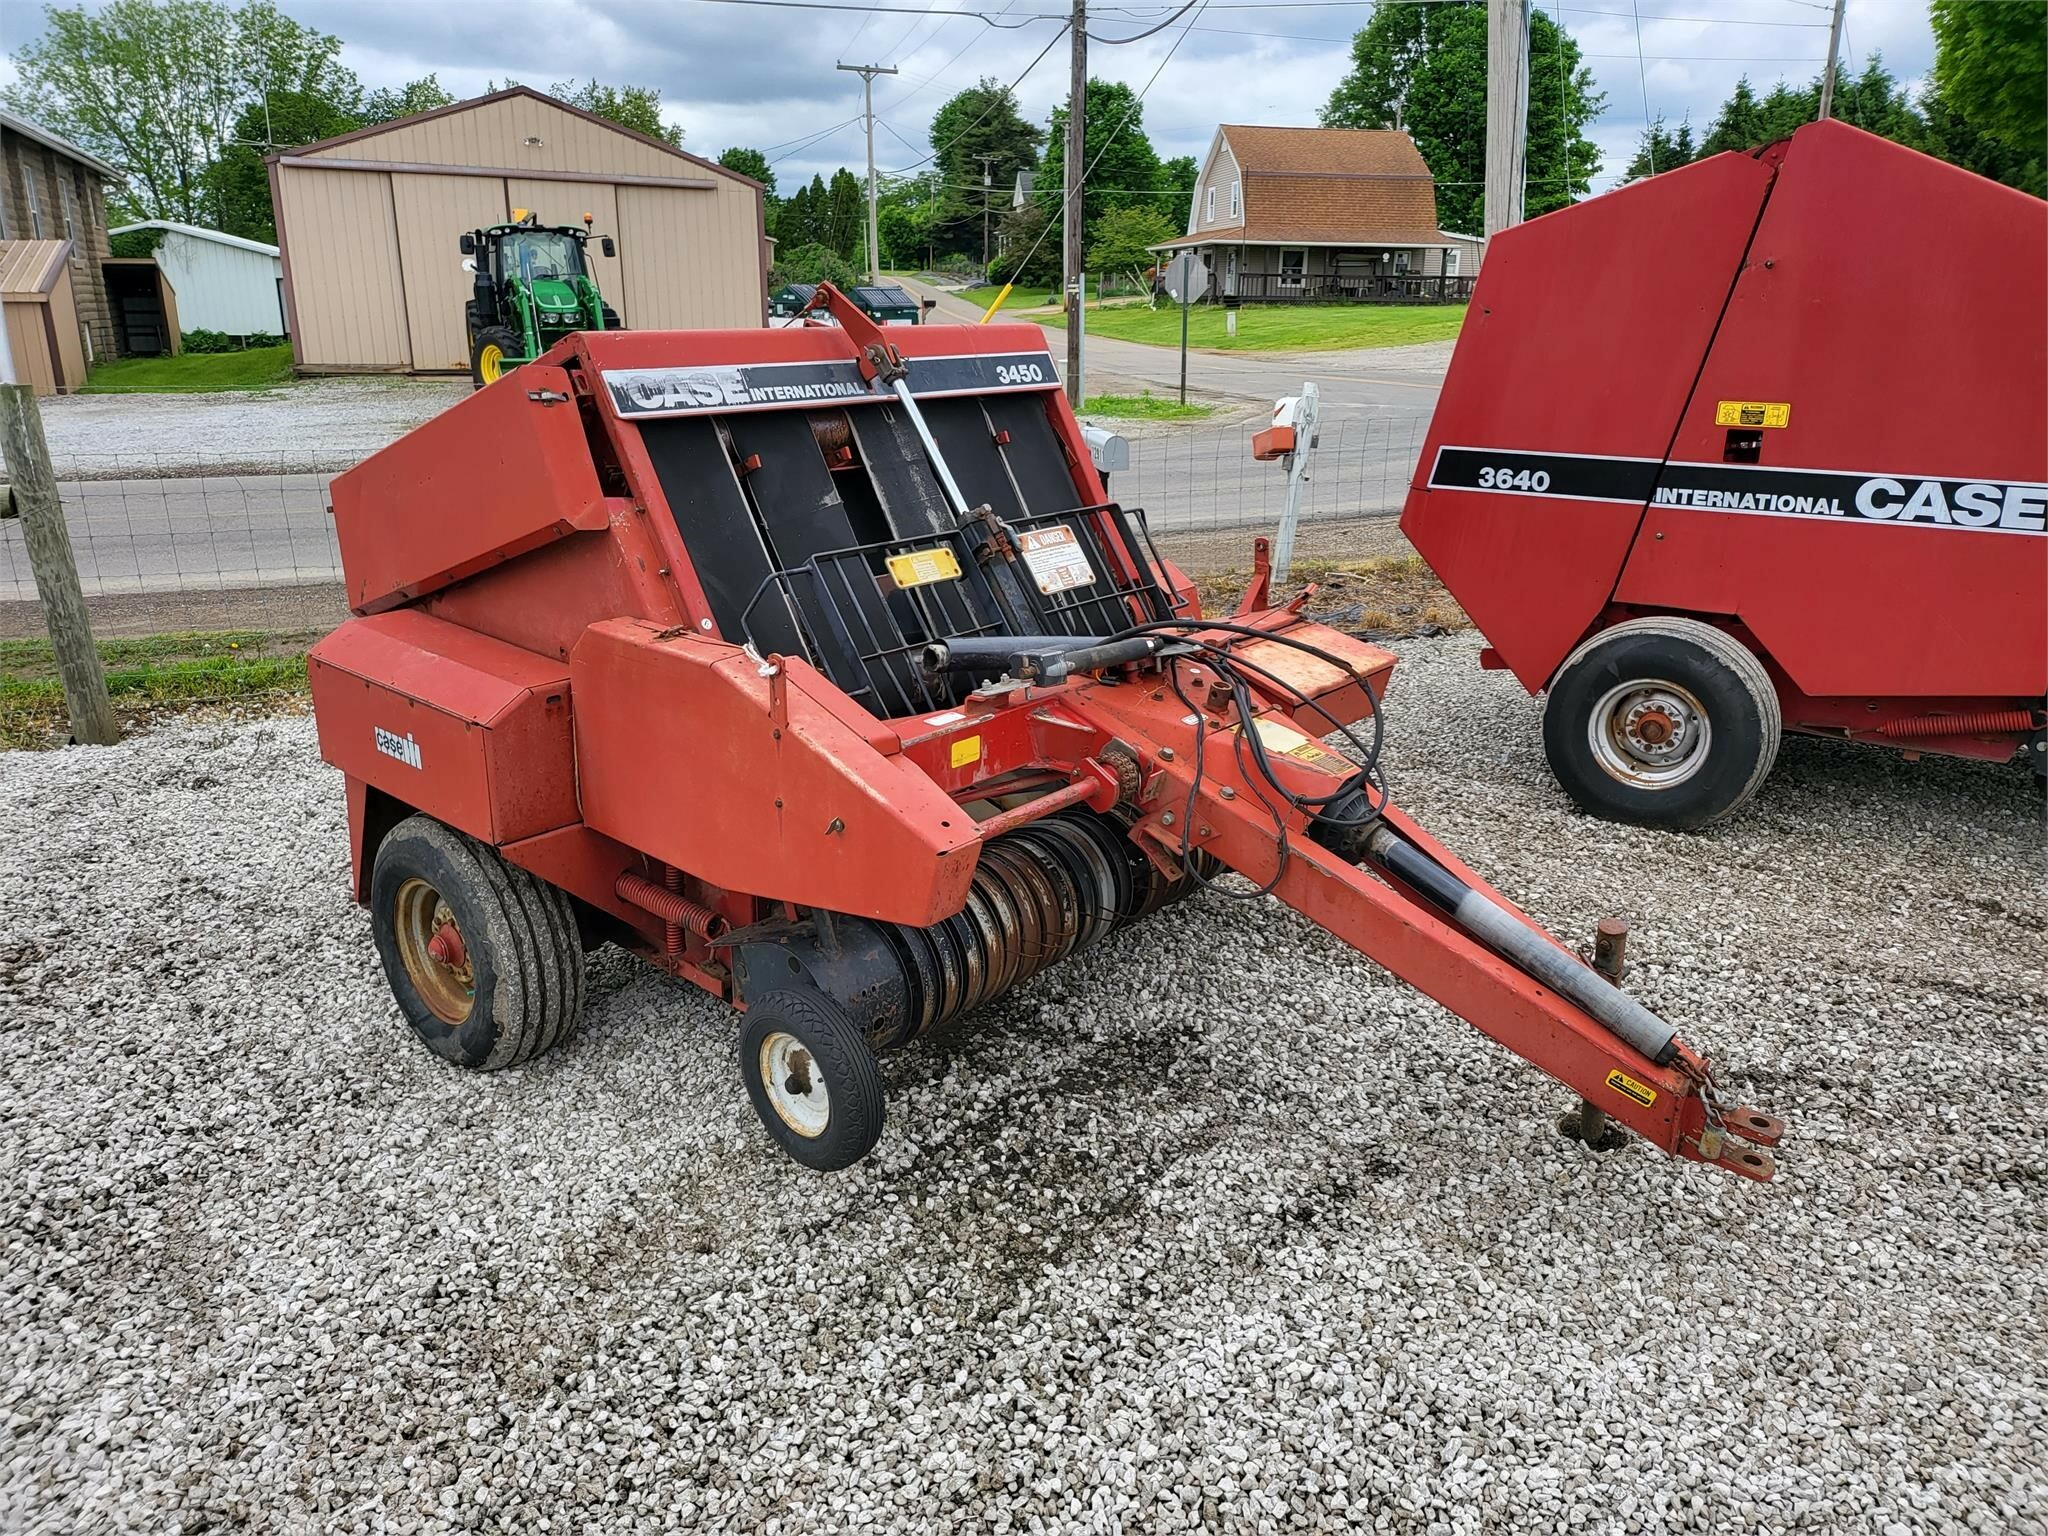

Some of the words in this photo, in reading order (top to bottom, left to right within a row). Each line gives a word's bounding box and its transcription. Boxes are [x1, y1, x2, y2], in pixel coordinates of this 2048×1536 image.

[996, 363, 1043, 384] 3450
[627, 370, 749, 410] CASE
[750, 381, 865, 402] INTERNATIONAL
[1478, 466, 1550, 492] 3640
[1654, 487, 1845, 516] INTERNATIONAL
[1855, 478, 2048, 531] CASE
[1625, 1079, 1652, 1097] CAUTION
